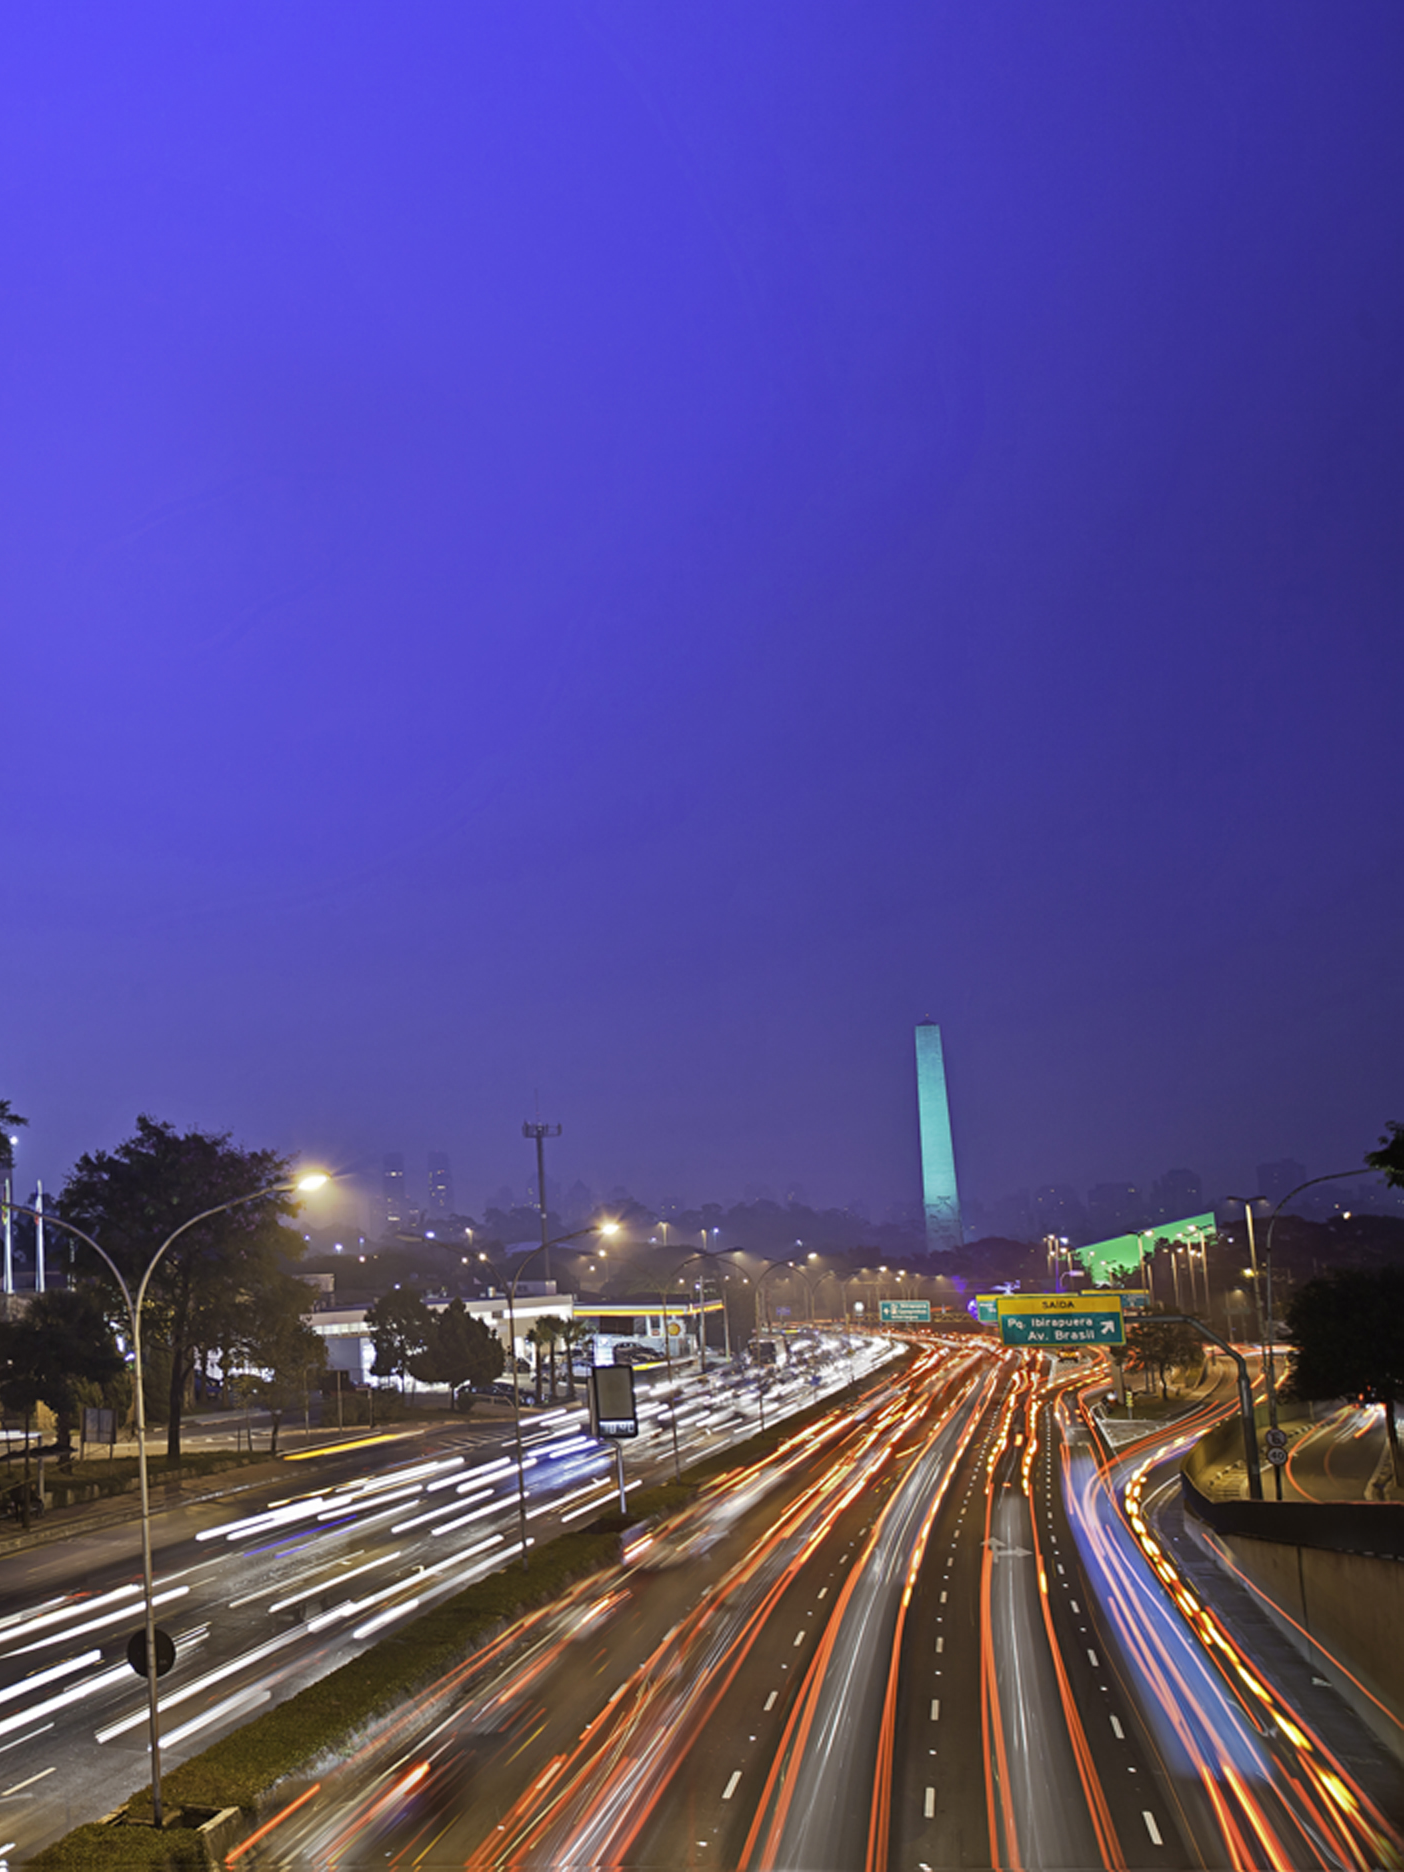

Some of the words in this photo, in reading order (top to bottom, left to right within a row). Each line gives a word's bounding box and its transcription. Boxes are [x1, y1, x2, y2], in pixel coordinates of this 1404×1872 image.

[1030, 1317, 1093, 1328] Ibirapuera
[1027, 1331, 1049, 1341] Av.
[1054, 1329, 1095, 1340] Brasil
